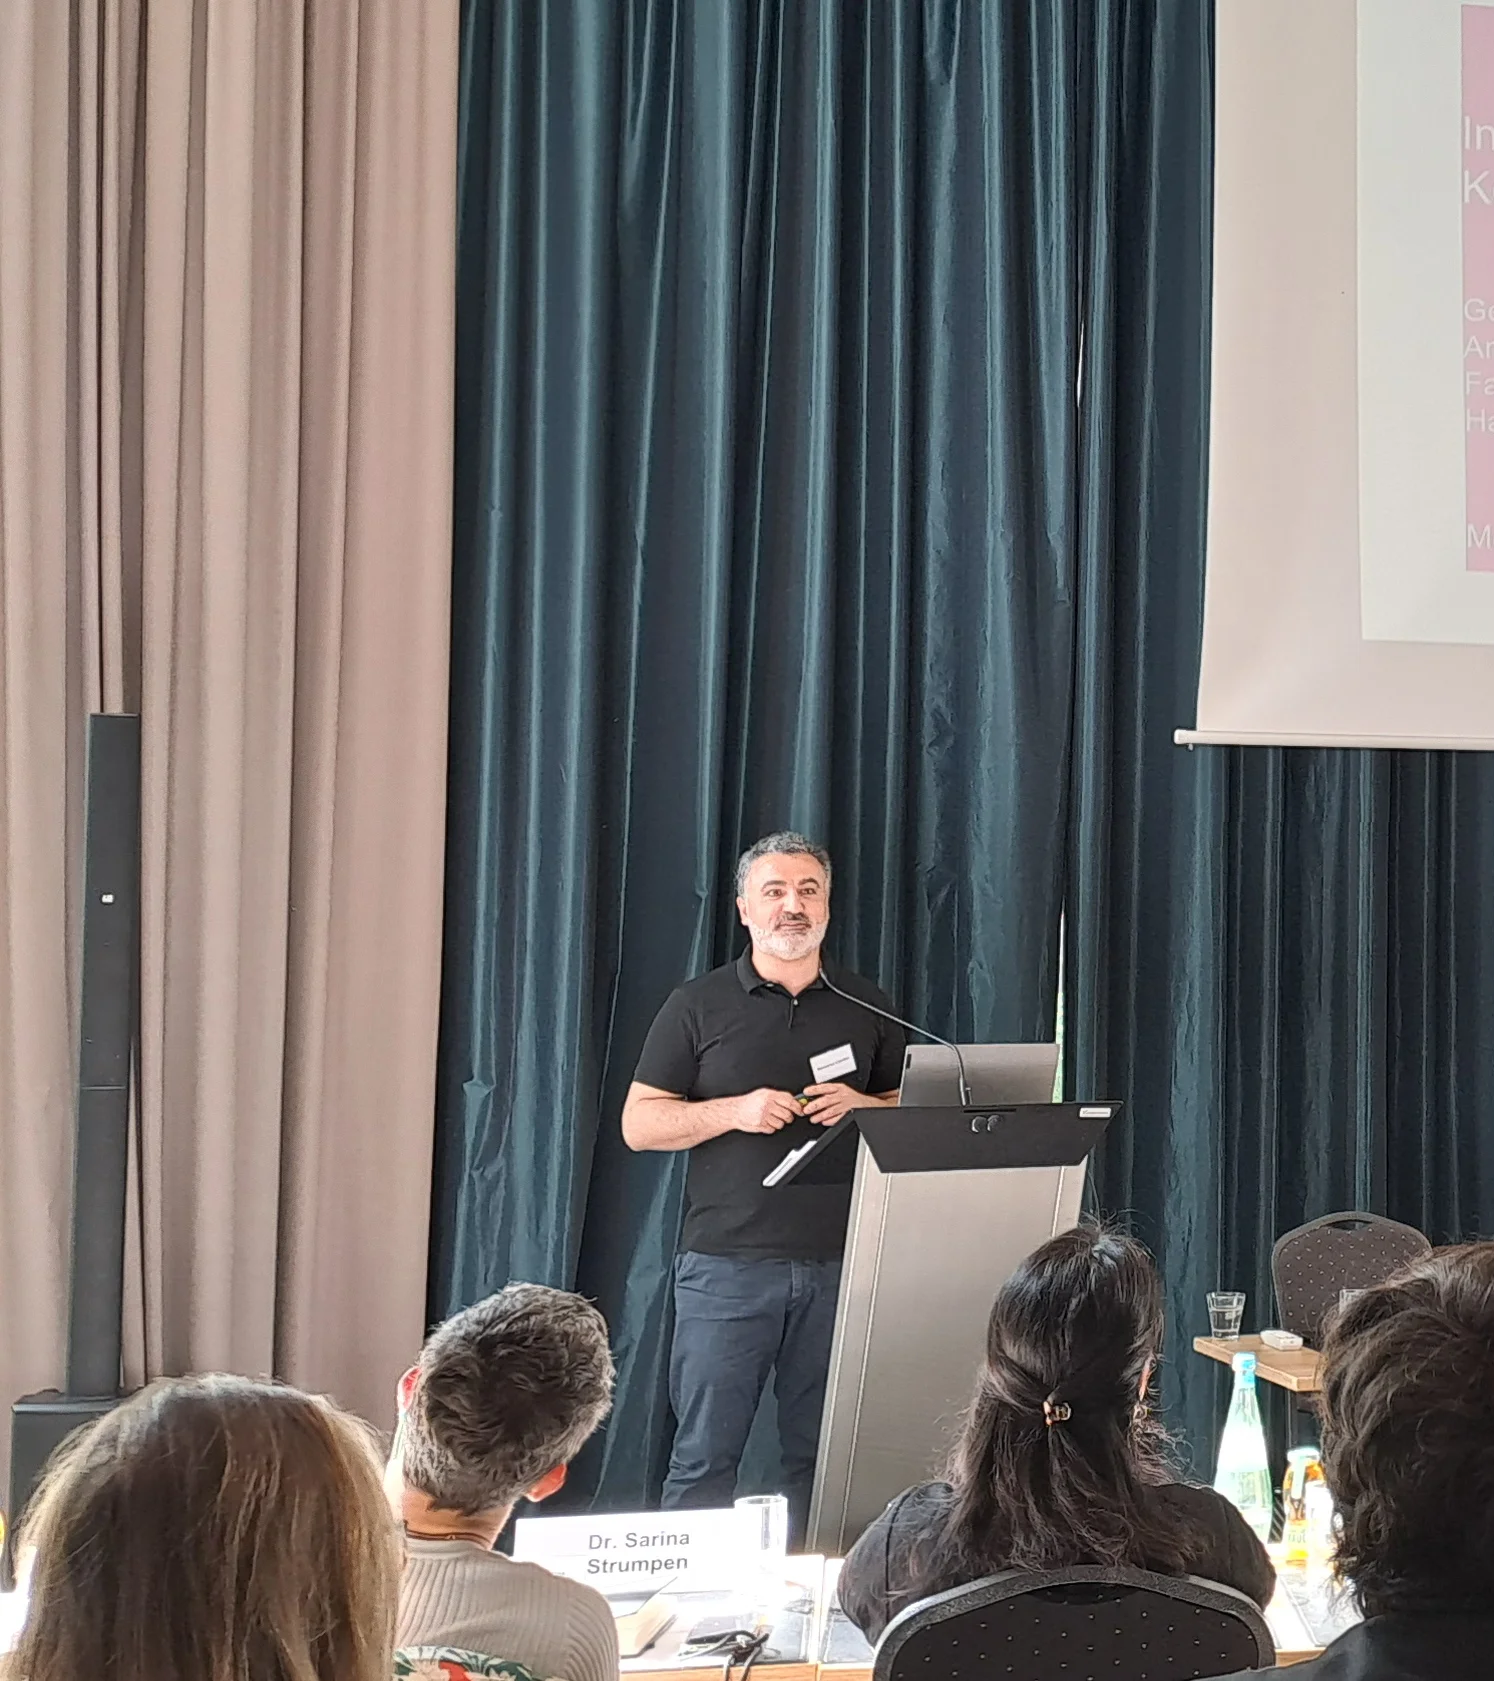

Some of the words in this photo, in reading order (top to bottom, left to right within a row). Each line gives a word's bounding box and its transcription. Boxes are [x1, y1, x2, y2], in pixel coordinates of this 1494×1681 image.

[589, 1534, 617, 1550] Dr.
[625, 1530, 690, 1548] Sarina
[587, 1557, 688, 1575] Strumpen
